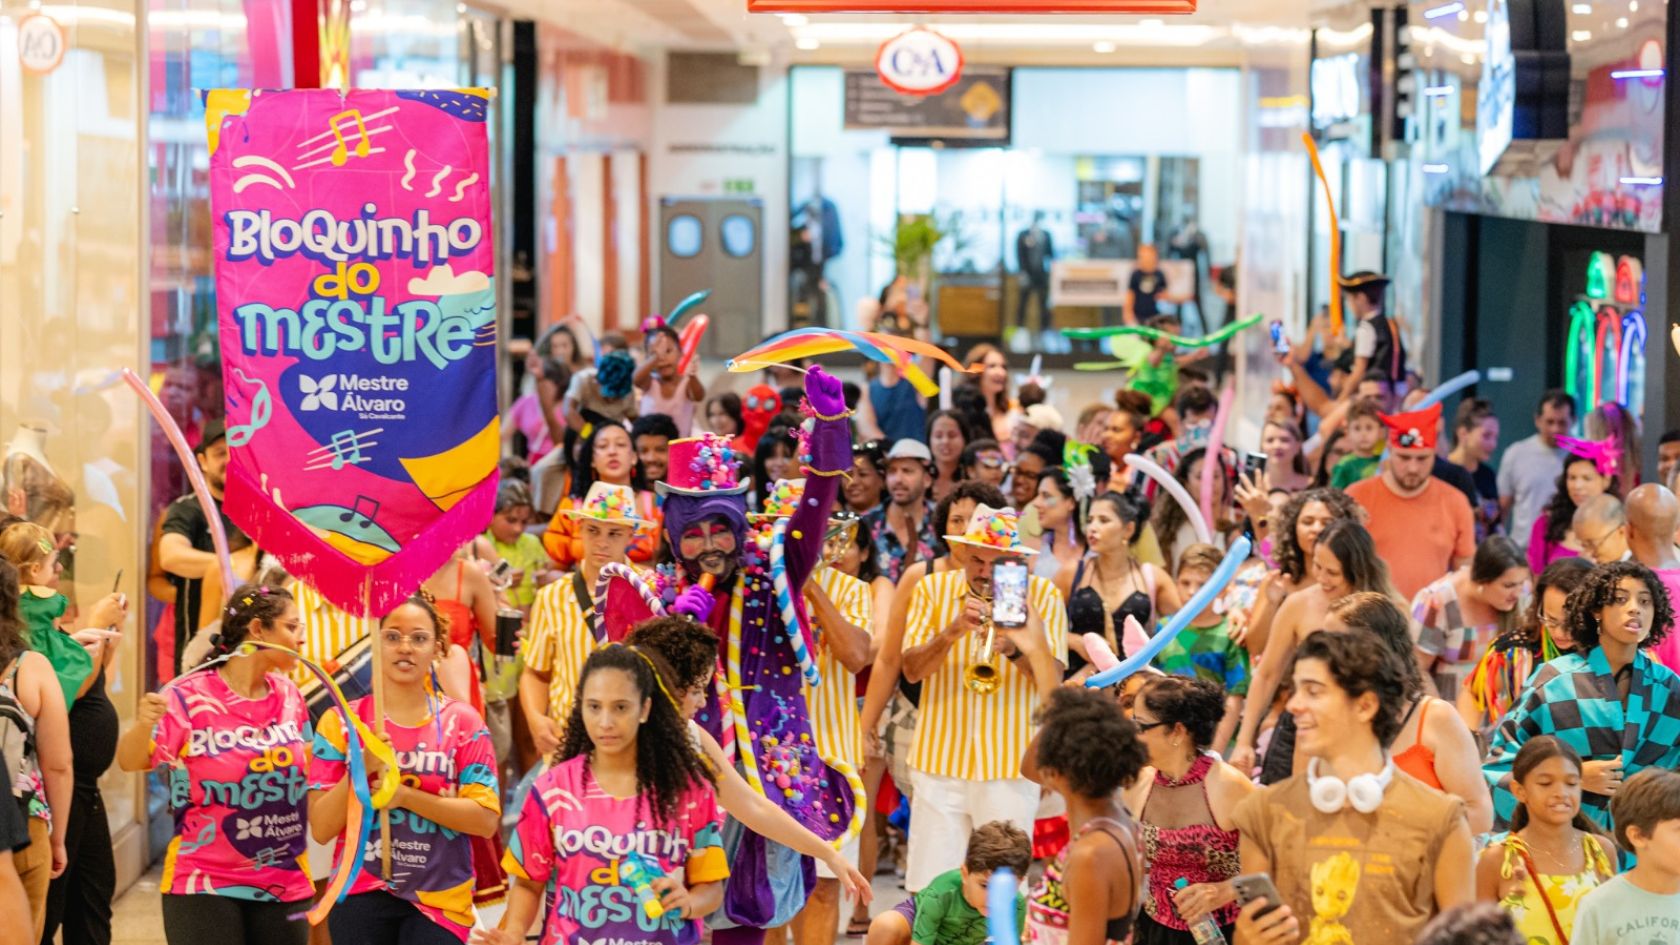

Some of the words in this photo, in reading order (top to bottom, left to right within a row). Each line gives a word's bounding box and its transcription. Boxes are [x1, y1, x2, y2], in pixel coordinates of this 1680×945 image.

[891, 45, 946, 77] C&A
[227, 202, 482, 264] BloQuinho
[313, 261, 381, 300] do
[339, 373, 409, 391] Mestre
[341, 391, 406, 412] Álvaro
[188, 719, 304, 757] BloQuin
[250, 746, 293, 772] do
[591, 860, 619, 886] d
